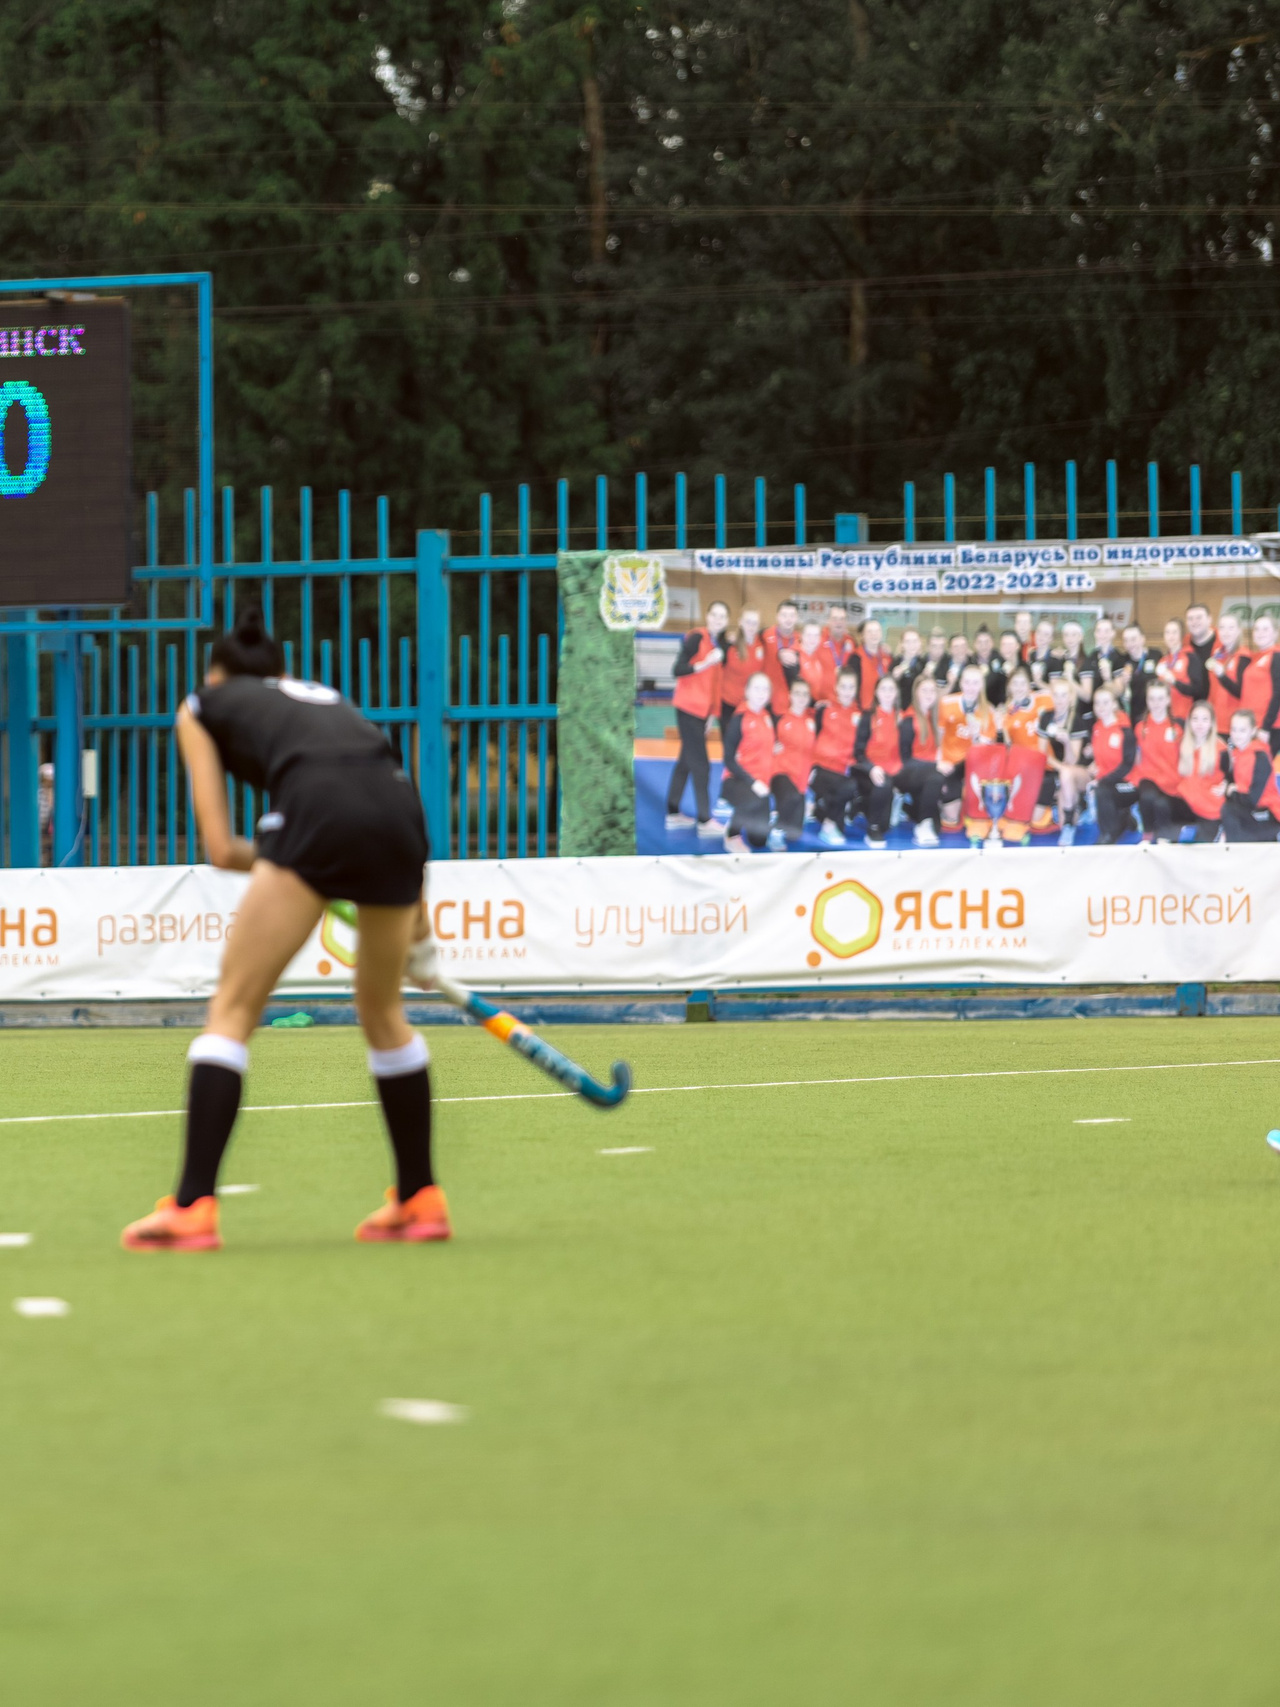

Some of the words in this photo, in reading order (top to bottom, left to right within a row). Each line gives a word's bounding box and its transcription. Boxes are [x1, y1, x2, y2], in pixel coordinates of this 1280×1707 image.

[698, 553, 814, 570] Чемпионы
[820, 549, 953, 571] Республики
[960, 547, 1065, 568] Беларусь
[1073, 548, 1099, 562] по
[1106, 543, 1259, 563] индорхоккею
[857, 575, 938, 592] сезона
[943, 571, 1058, 591] 2022-2023
[1065, 573, 1092, 589] гг.
[575, 896, 749, 948] улучшай
[1087, 886, 1253, 938] увлекай
[892, 936, 1028, 951] БЕЛТЭЛЕКАМ
